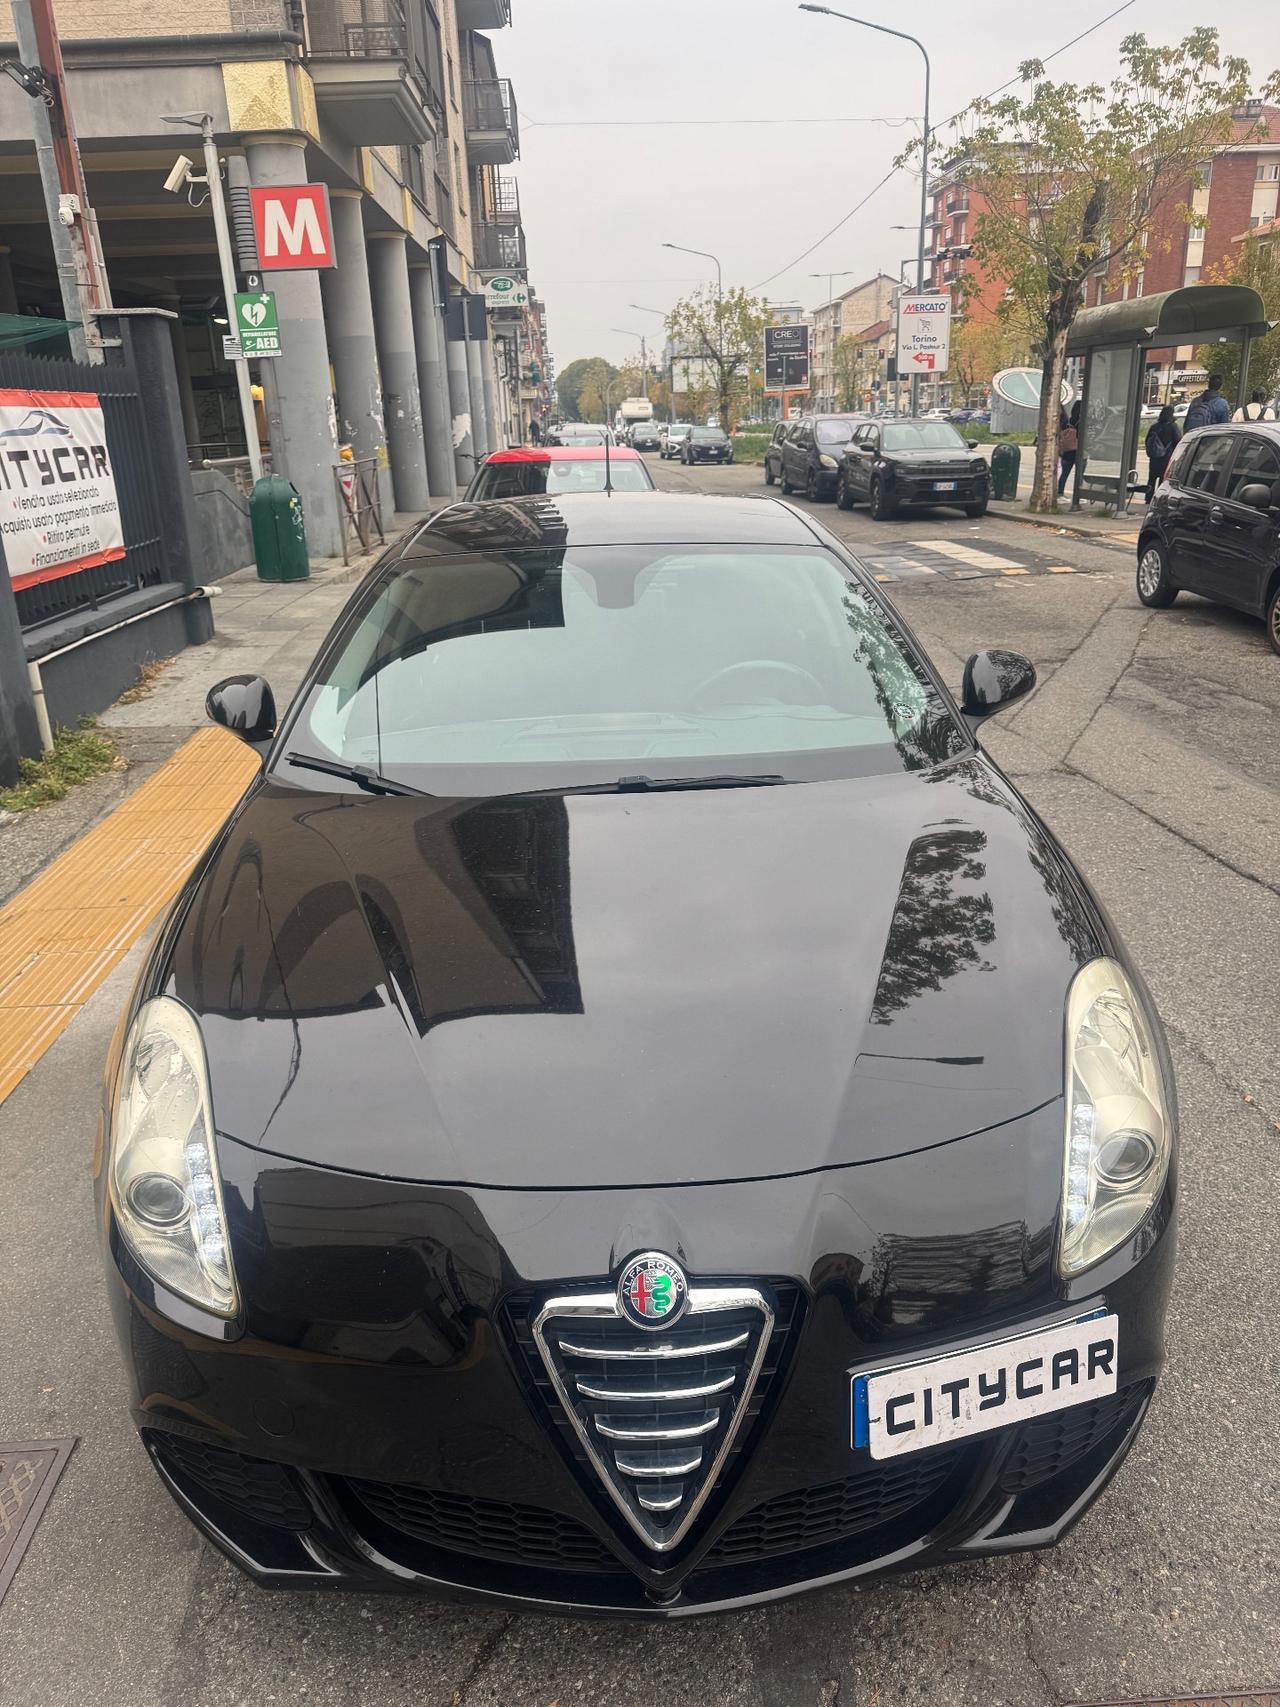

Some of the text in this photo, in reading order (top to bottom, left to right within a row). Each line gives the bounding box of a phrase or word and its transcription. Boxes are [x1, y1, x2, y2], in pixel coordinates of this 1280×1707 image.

[264, 198, 326, 256] M
[904, 302, 946, 313] MERCATO
[256, 337, 279, 349] AED
[912, 334, 937, 343] Torino
[0, 445, 111, 490] ITYCAR
[15, 485, 100, 511] Vendita usato selezionato
[32, 512, 53, 528] usato
[54, 505, 90, 528] pagamento
[90, 500, 117, 516] immediato
[47, 523, 90, 545] Ritiro permute
[35, 538, 101, 567] Finanziamenti in sede
[623, 1261, 684, 1296] ALFA ROMEO
[885, 1338, 1115, 1436] CITYCAR
